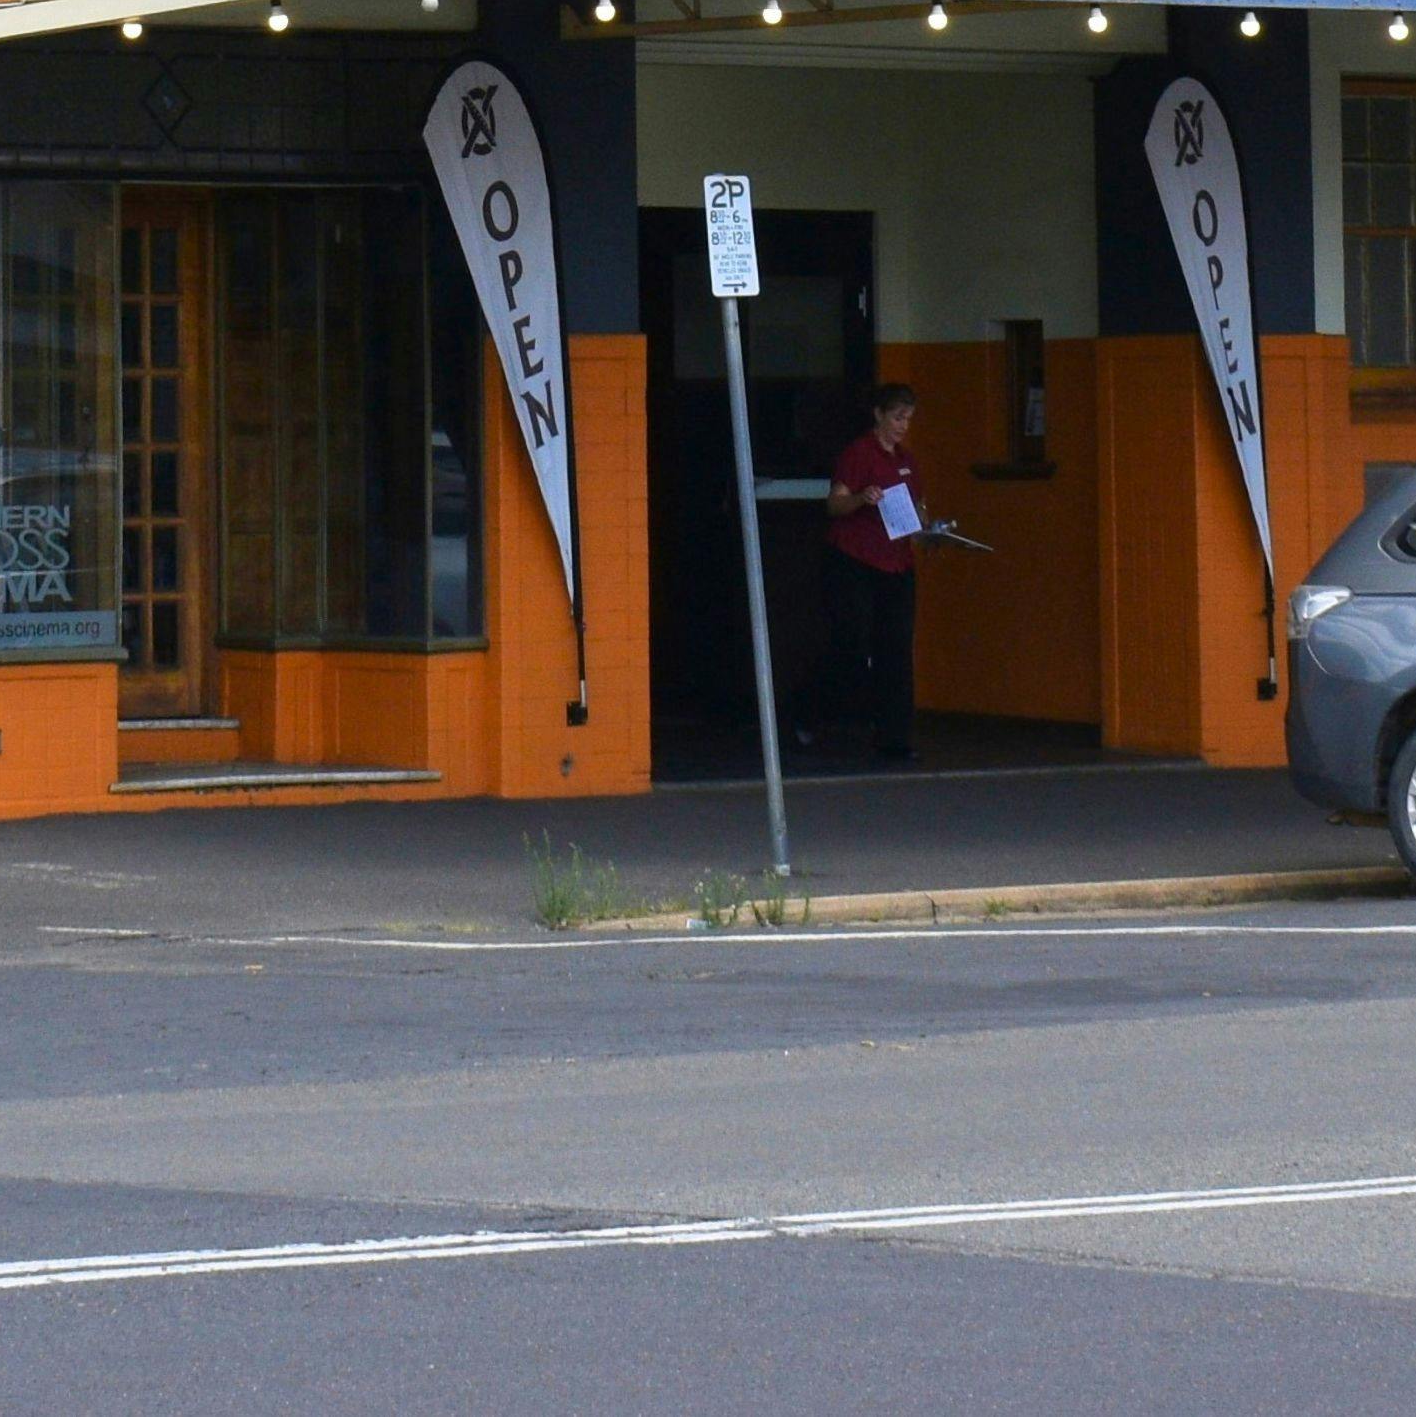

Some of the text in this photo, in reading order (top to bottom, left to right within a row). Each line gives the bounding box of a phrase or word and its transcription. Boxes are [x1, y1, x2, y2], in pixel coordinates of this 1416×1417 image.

[483, 180, 558, 449] OPEN
[710, 179, 744, 208] 2P
[1192, 189, 1256, 442] OPEN
